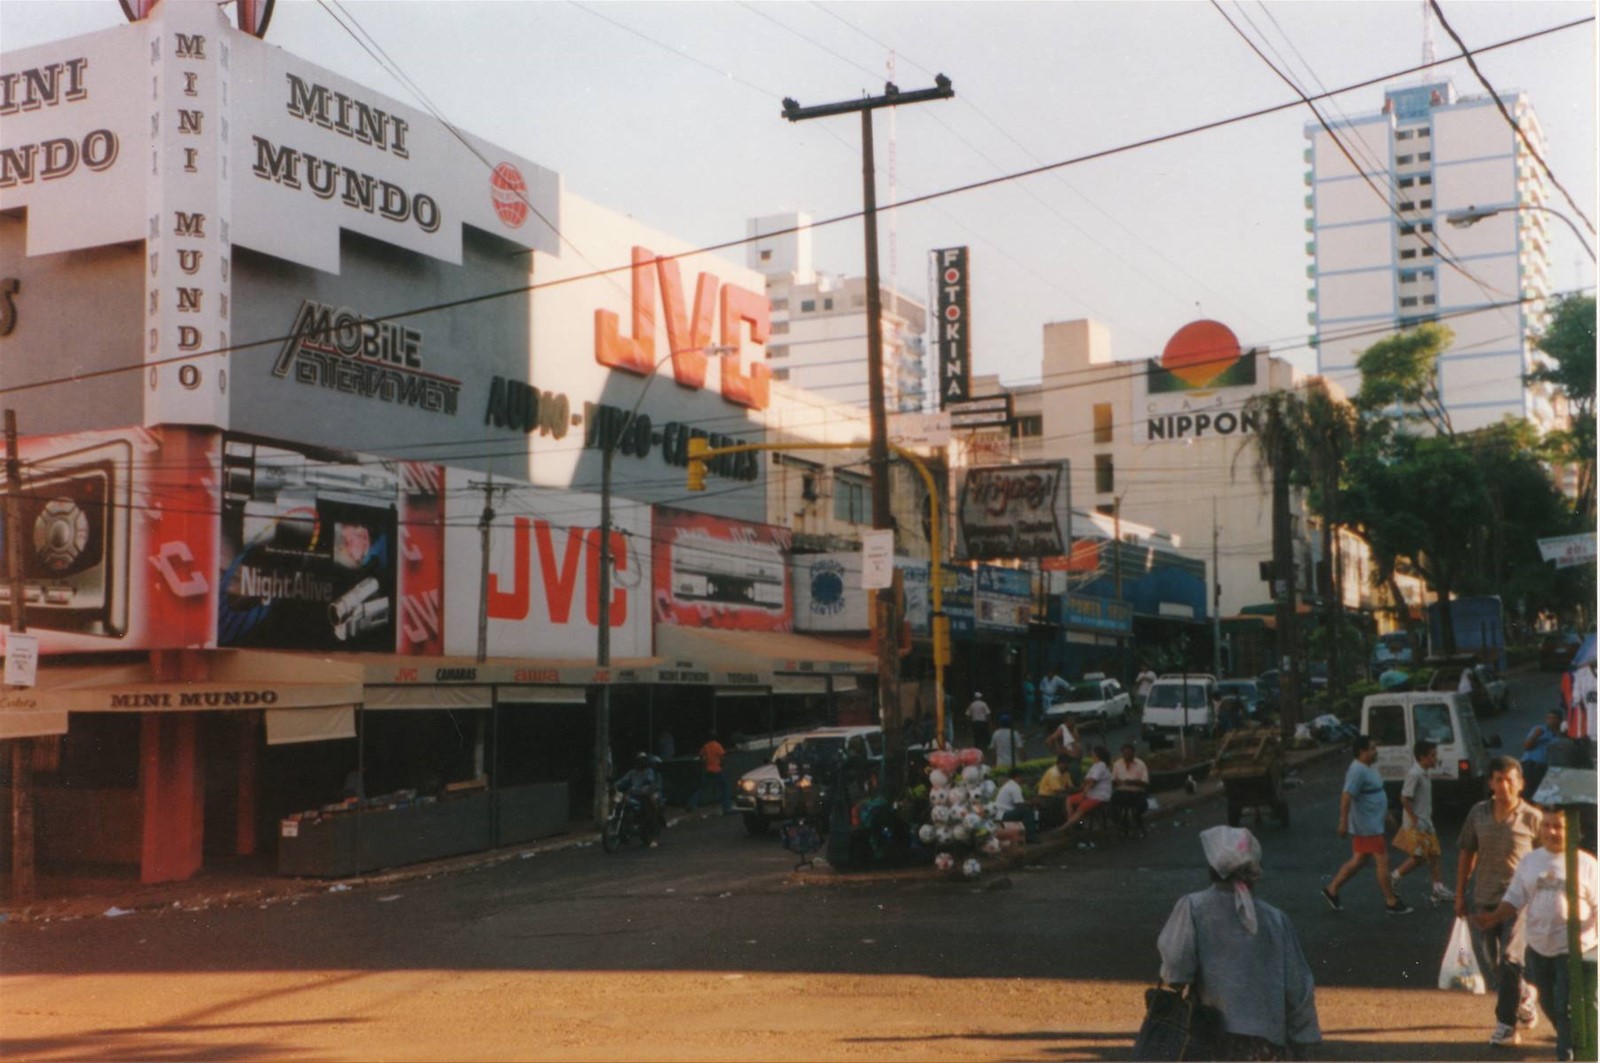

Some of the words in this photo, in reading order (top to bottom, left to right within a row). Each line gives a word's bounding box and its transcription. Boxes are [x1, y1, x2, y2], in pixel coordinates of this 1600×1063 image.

[175, 32, 206, 174] MINI
[286, 72, 409, 159] MINI
[252, 135, 441, 232] MUNDO
[173, 210, 206, 391] MUNDO
[594, 245, 770, 411] JVC
[943, 248, 962, 397] FOTOKINA
[1146, 409, 1260, 441] NIPPON
[239, 565, 334, 606] NightAlive
[488, 516, 627, 628] JVC
[110, 692, 173, 709] MINI
[179, 690, 278, 708] MUNDO
[394, 667, 418, 682] JVC
[435, 667, 477, 681] CAMARAS
[513, 668, 561, 683] aiwa
